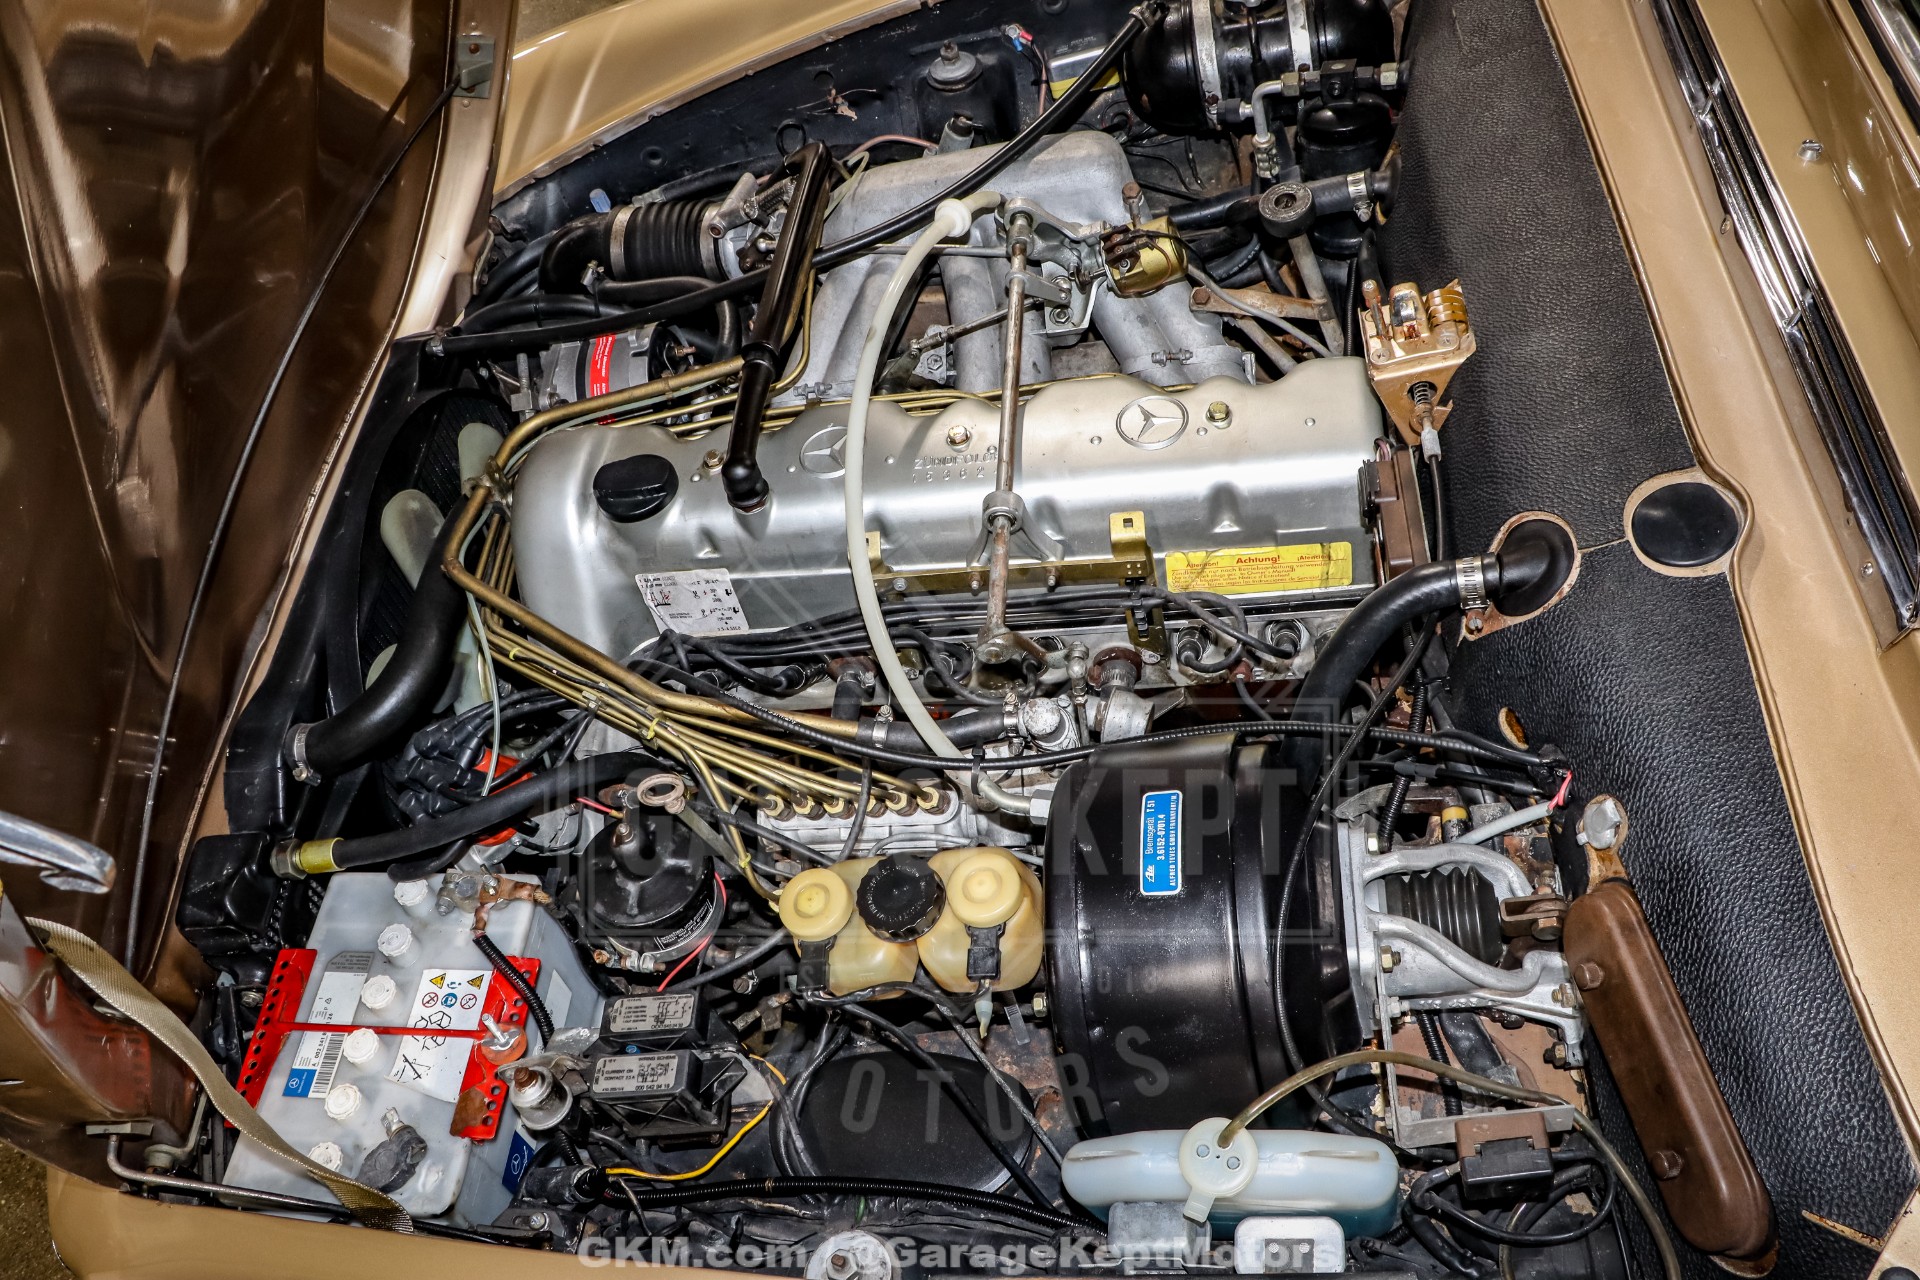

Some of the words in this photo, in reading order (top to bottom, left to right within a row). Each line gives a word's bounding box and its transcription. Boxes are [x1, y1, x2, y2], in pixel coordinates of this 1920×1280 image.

[1236, 555, 1280, 565] Achtung!
[1147, 800, 1156, 808] 51
[1145, 816, 1157, 855] Bremsgerät
[1157, 814, 1167, 861] 3.6152-0701.4
[1169, 867, 1177, 887] ALFRED
